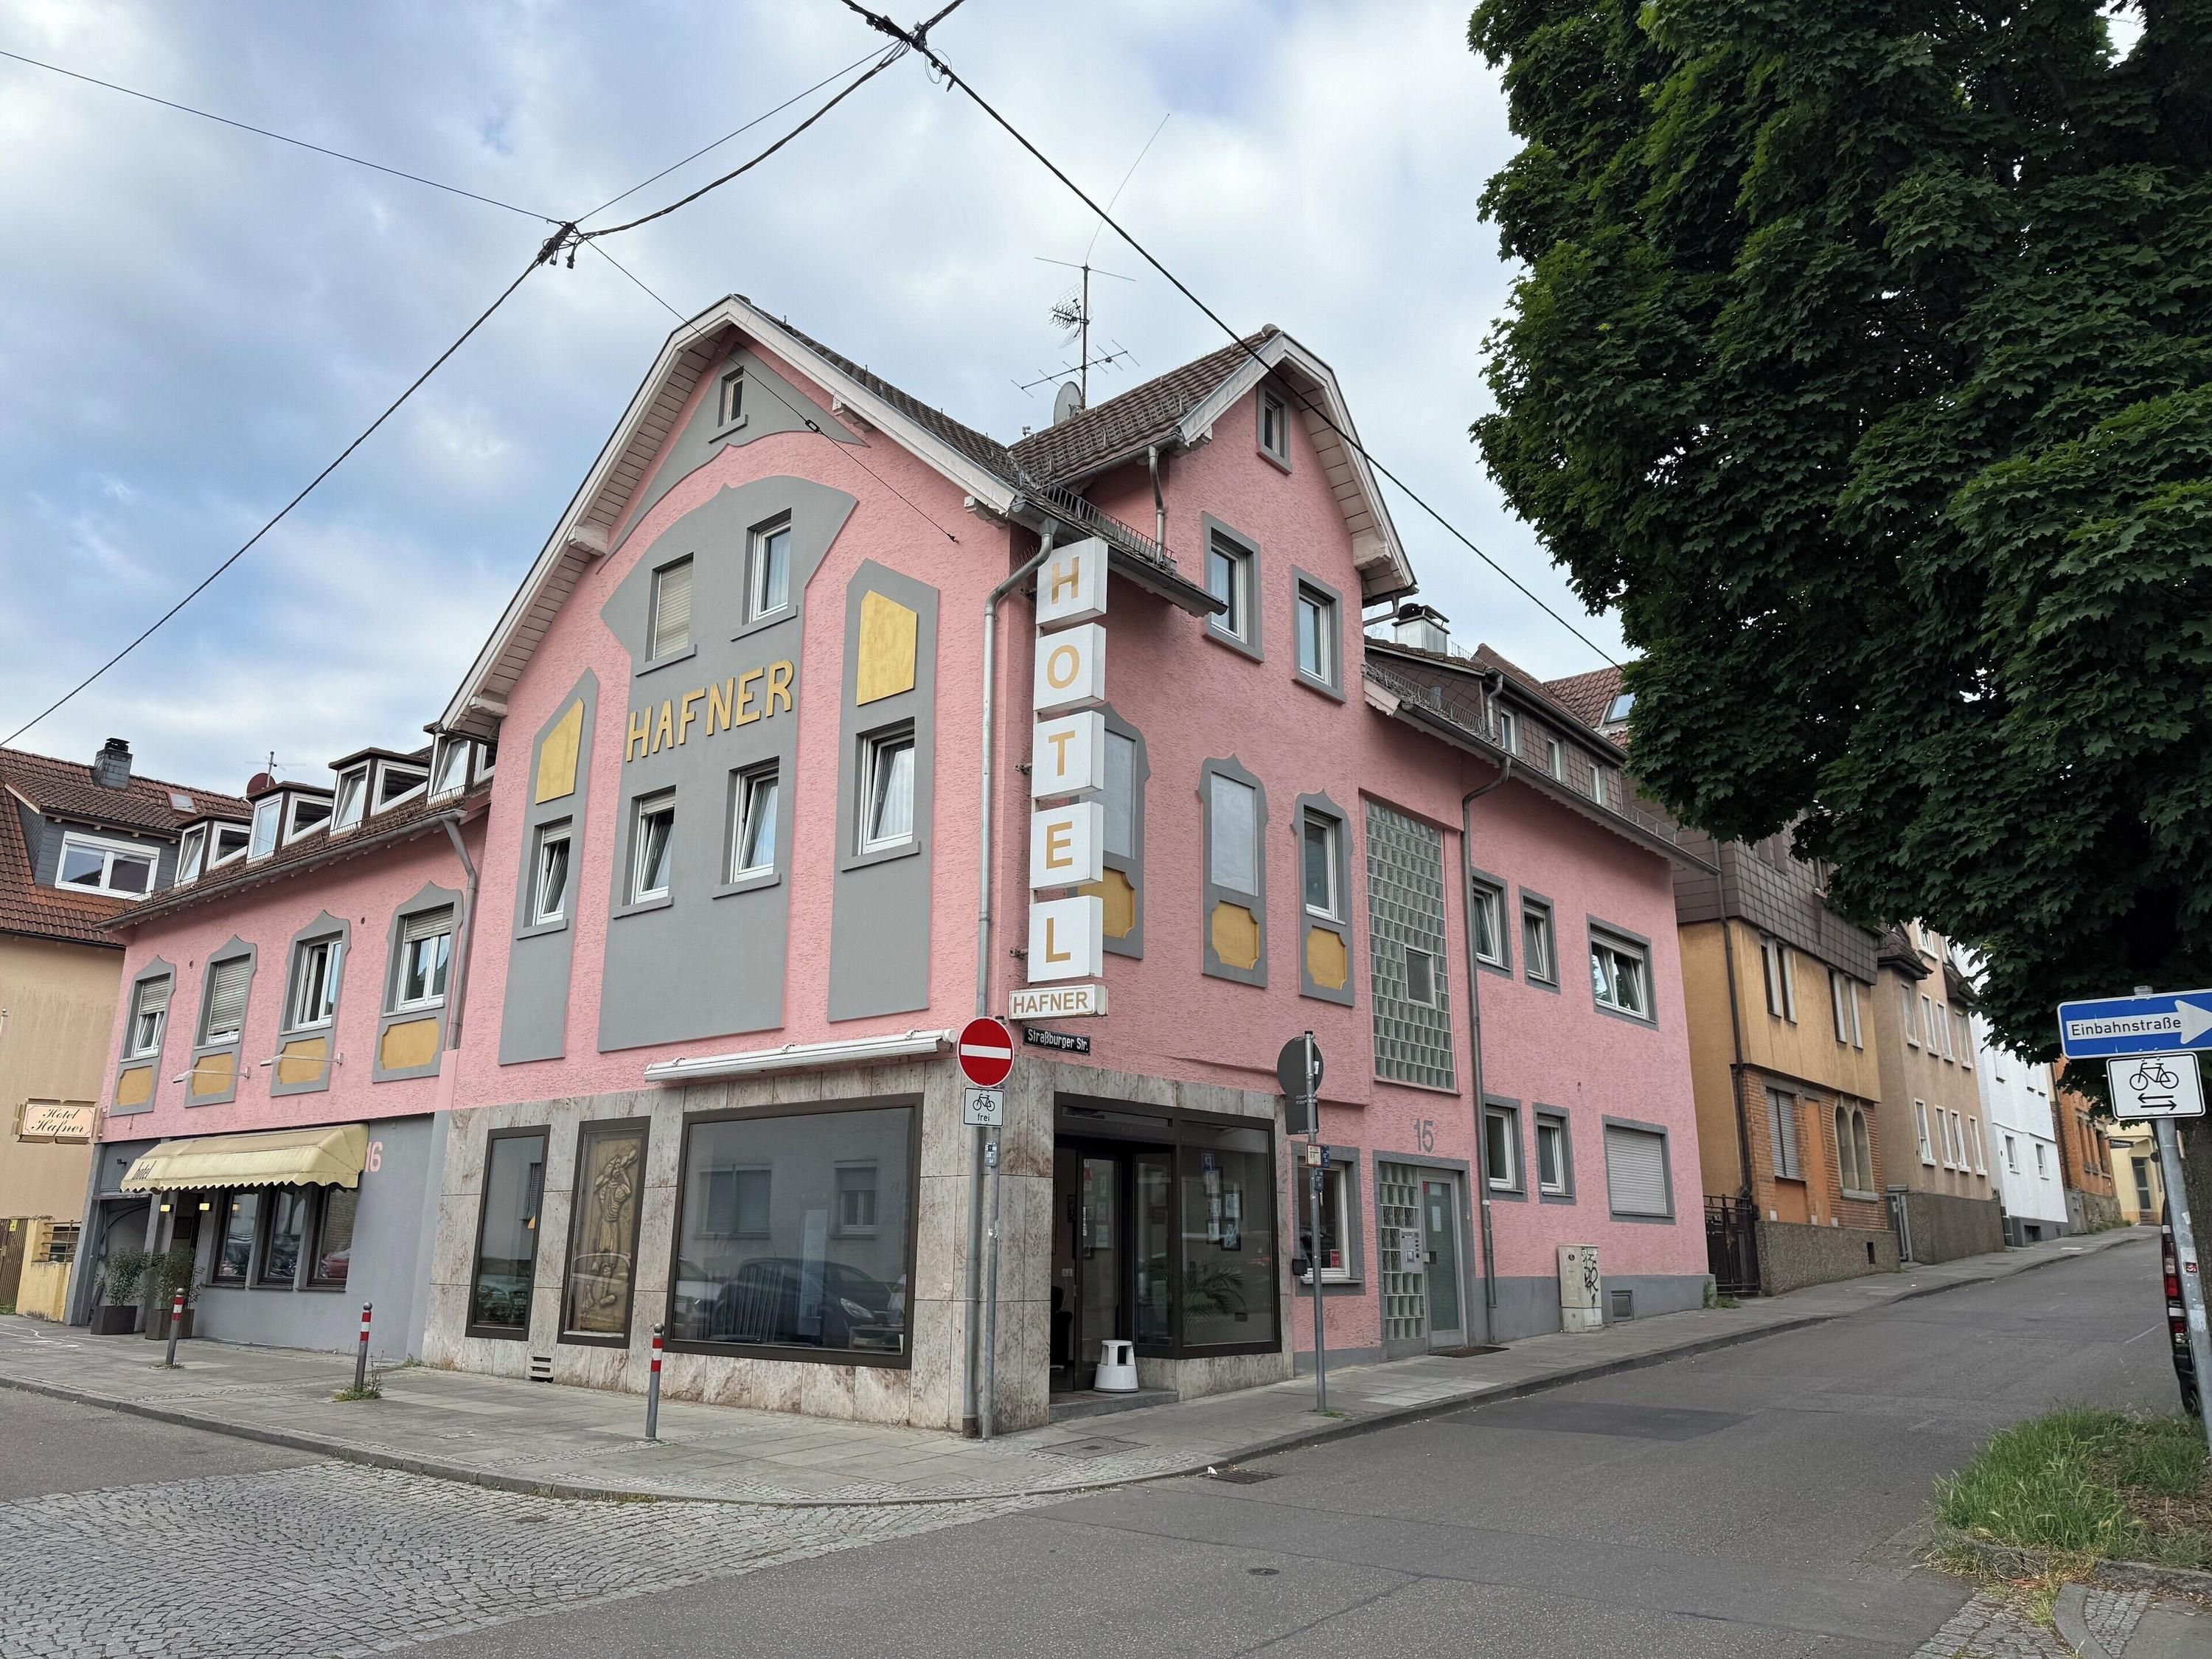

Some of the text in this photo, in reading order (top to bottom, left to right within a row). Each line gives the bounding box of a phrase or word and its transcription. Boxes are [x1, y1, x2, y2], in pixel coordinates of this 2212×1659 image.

[626, 660, 794, 762] HAFNER
[1046, 556, 1080, 964] HOTEL
[1013, 991, 1088, 1015] HAFNER
[2071, 1017, 2182, 1036] Einbahnstraße
[1028, 1029, 1088, 1051] Straßburger Str.
[43, 1108, 80, 1119] Hotel
[978, 1113, 990, 1121] frei
[31, 1119, 84, 1136] Hafner
[1413, 1118, 1434, 1152] 15
[364, 1141, 383, 1172] 16
[131, 1160, 157, 1180] hotel
